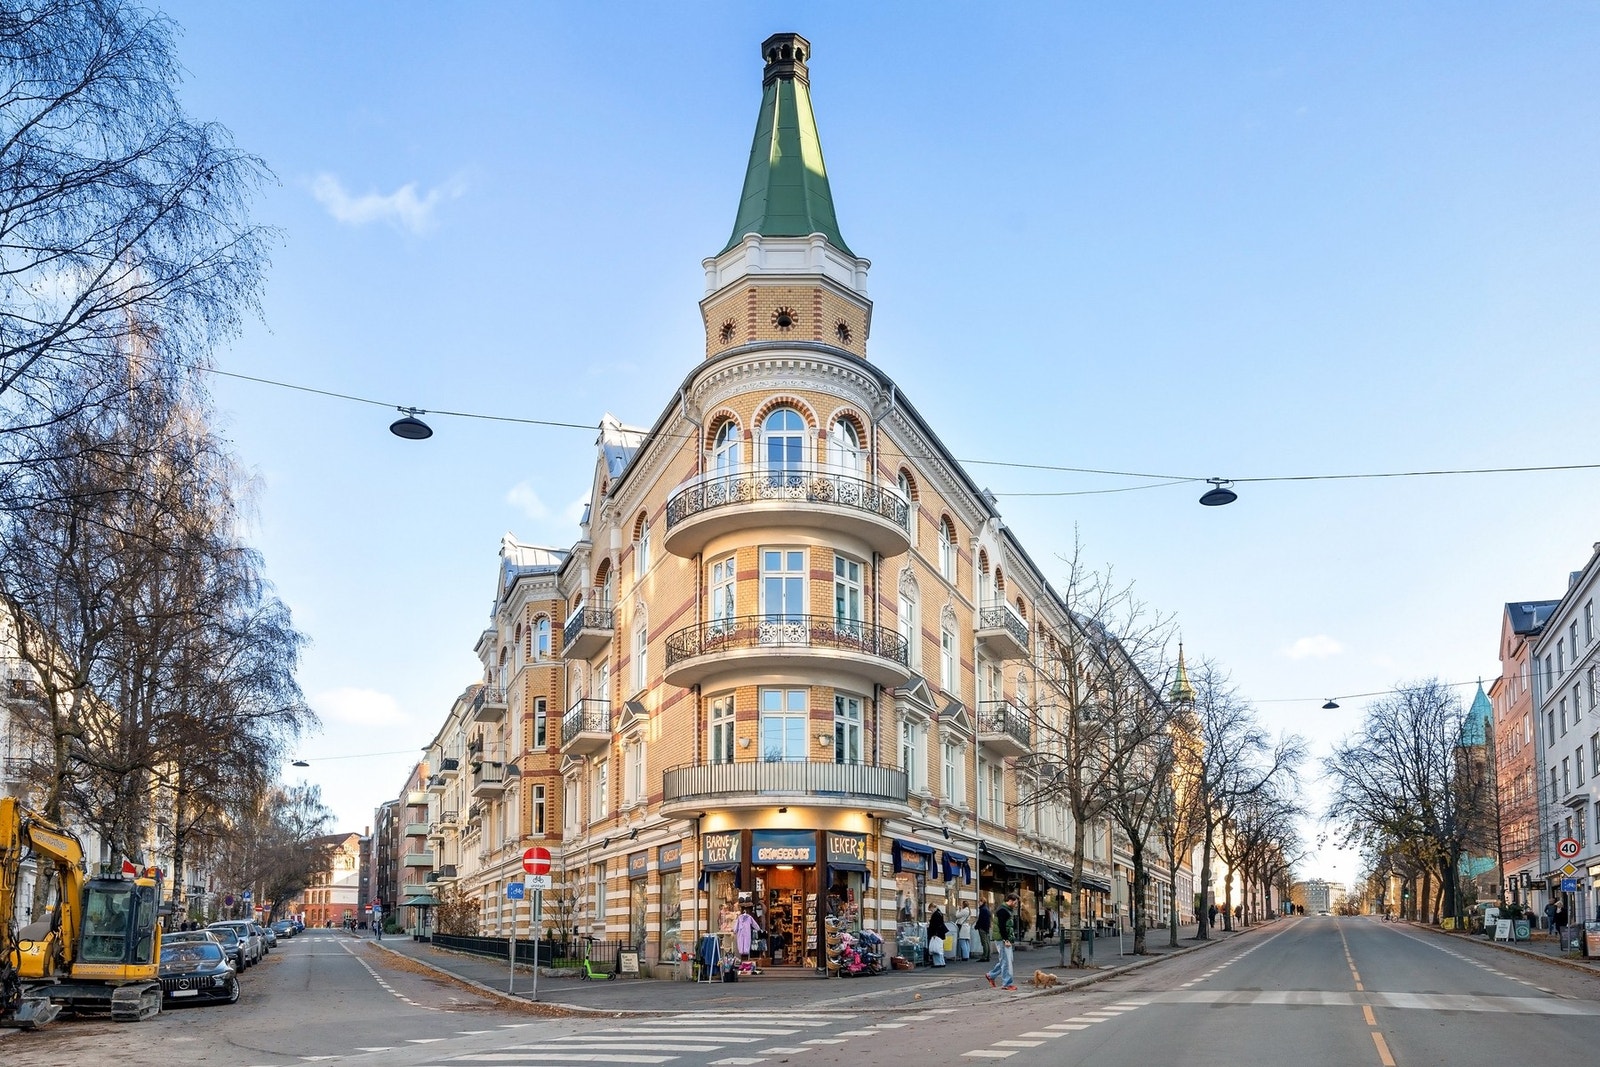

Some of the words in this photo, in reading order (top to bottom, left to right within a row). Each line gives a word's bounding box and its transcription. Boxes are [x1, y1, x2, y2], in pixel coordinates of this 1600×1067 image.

[706, 834, 732, 849] BARNE-
[830, 837, 857, 858] LEKER
[1561, 843, 1577, 853] 40
[708, 848, 727, 862] KLÆR
